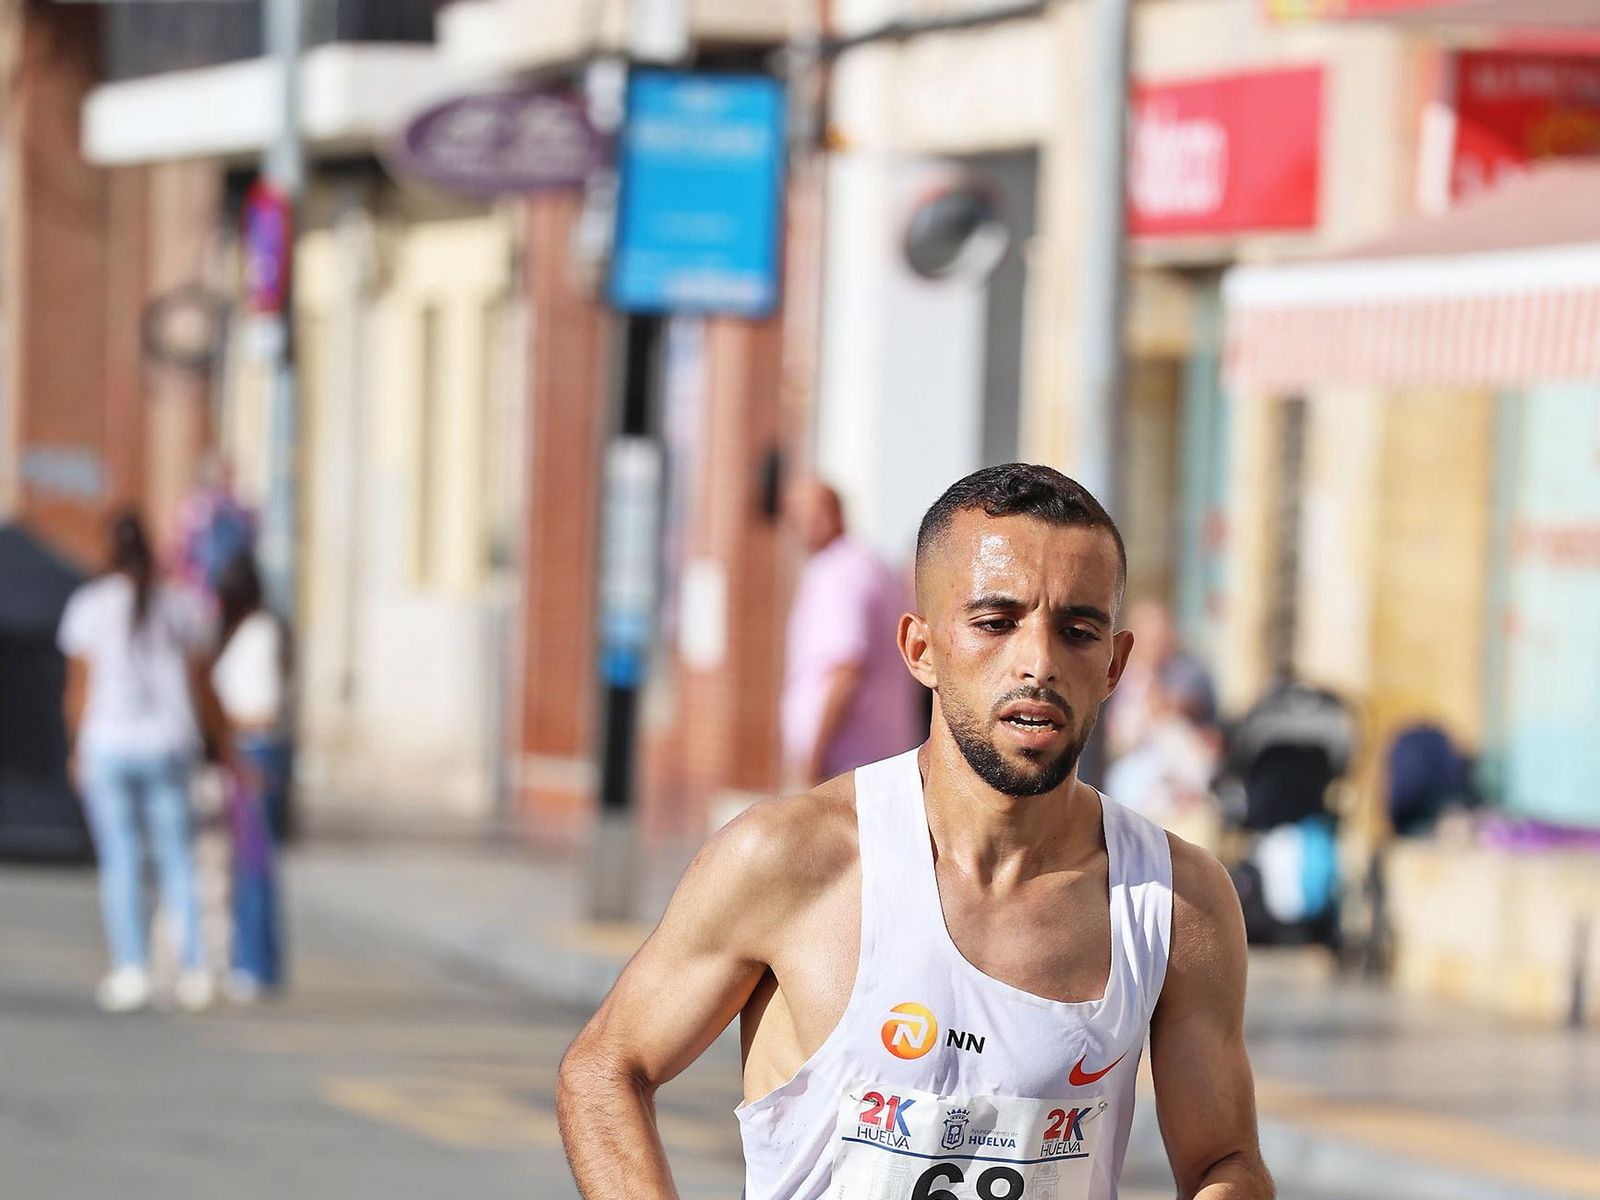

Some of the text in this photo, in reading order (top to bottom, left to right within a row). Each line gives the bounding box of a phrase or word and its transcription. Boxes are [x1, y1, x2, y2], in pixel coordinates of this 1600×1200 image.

[946, 1028, 986, 1054] NN
[858, 1091, 918, 1138] 21K
[1043, 1107, 1093, 1141] 21K
[857, 1126, 911, 1151] HUELVA
[968, 1136, 1016, 1149] HUELVA
[1040, 1141, 1082, 1157] HUELVA
